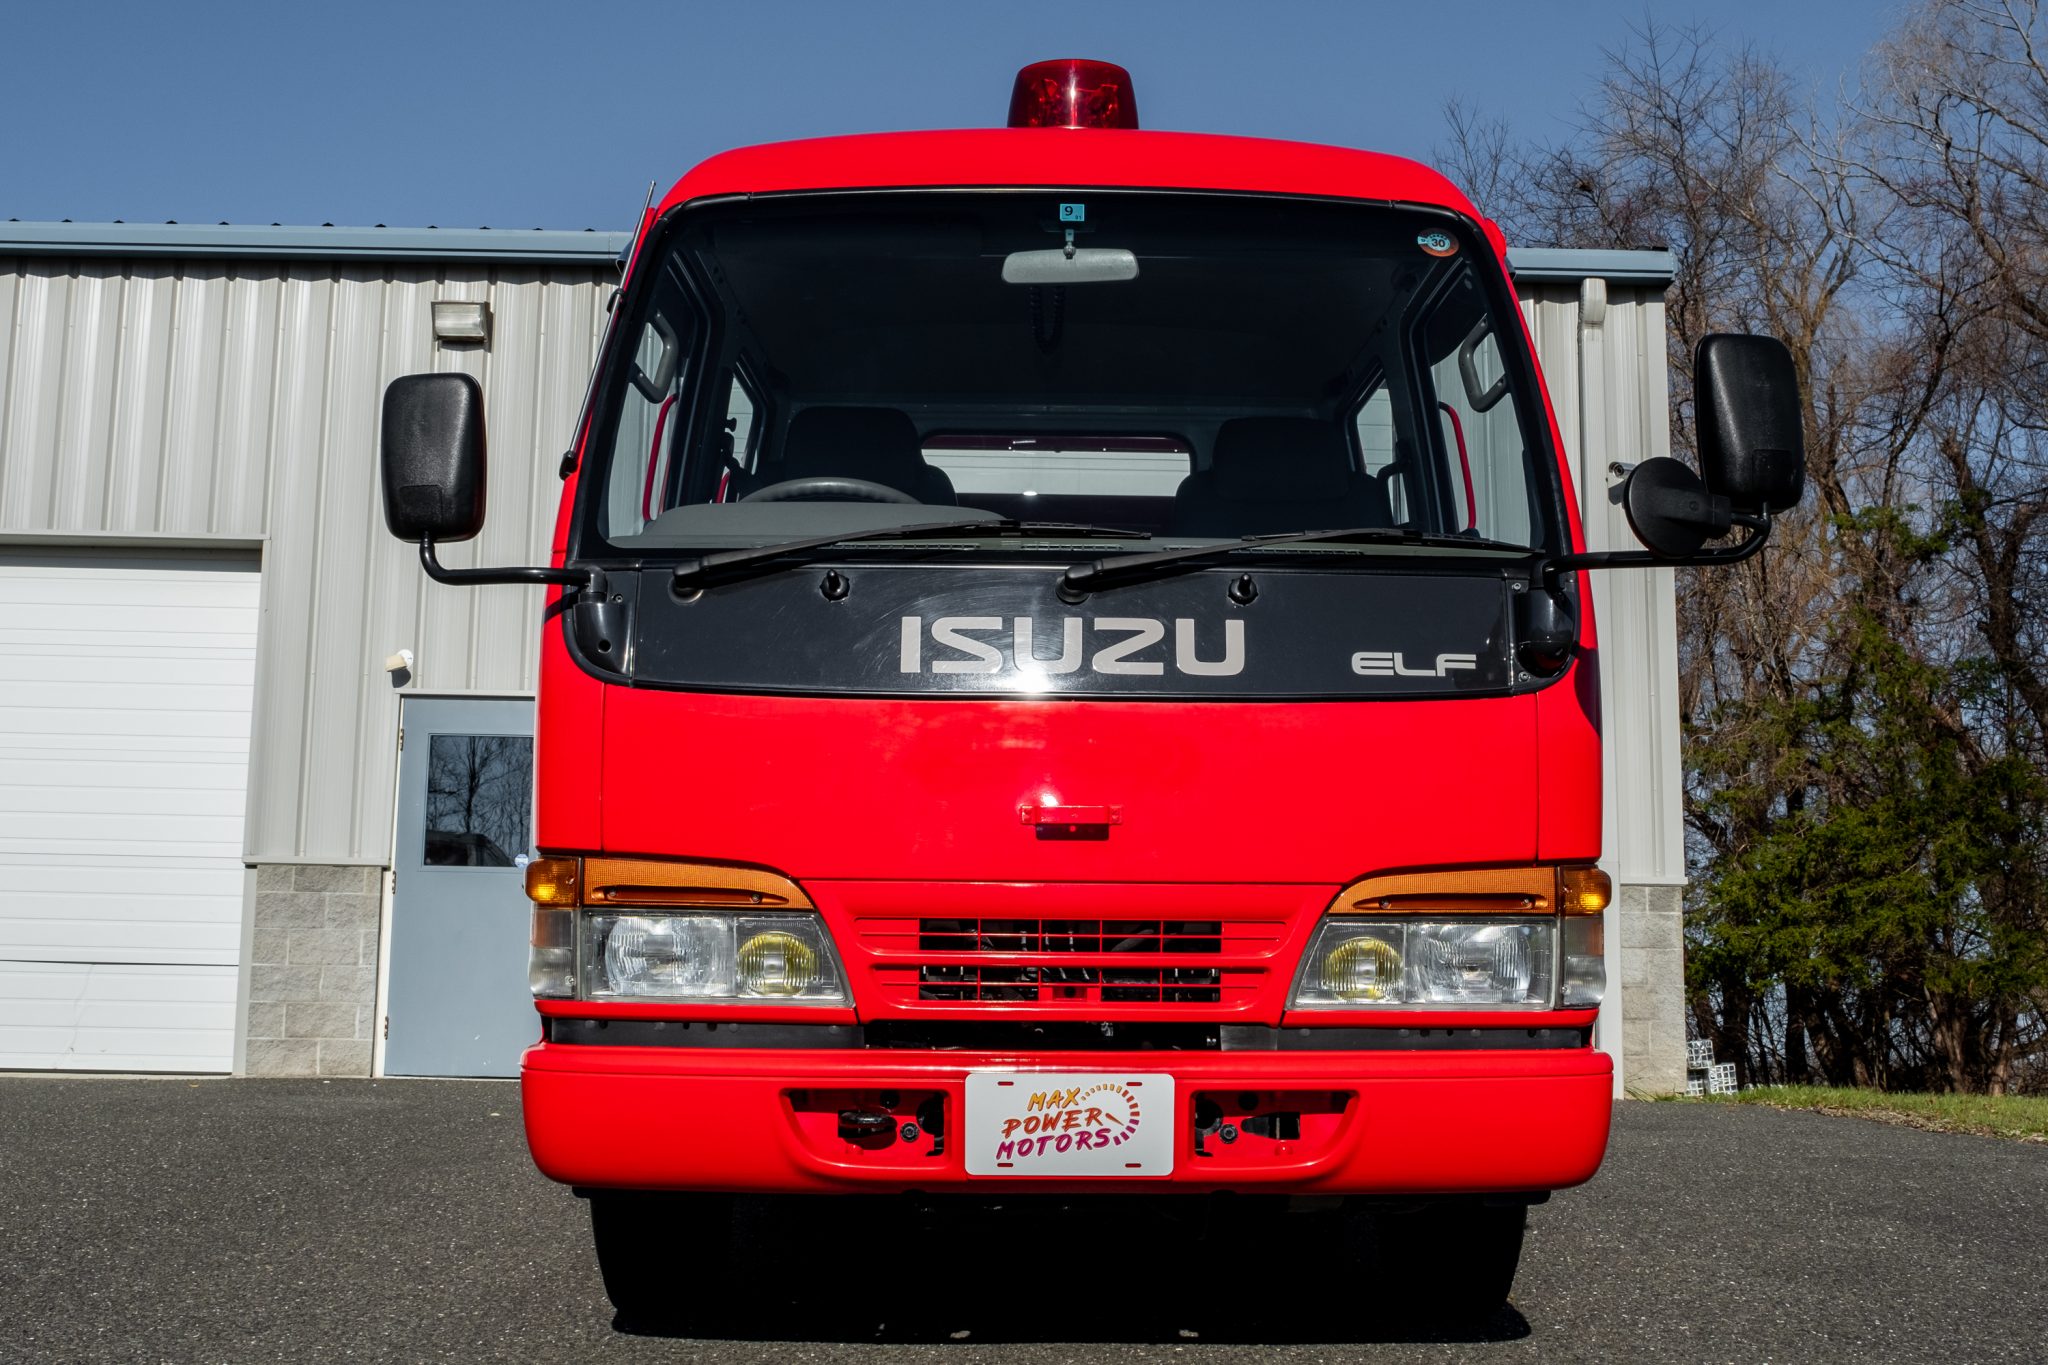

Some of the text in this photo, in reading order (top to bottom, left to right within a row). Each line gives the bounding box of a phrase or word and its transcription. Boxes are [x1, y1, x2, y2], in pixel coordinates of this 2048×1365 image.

[1064, 205, 1073, 216] 9
[1431, 238, 1446, 248] 30
[900, 616, 1245, 676] ISUZU
[1351, 651, 1477, 677] ELF
[1027, 1087, 1080, 1112] MAX
[1001, 1107, 1103, 1139] POWER
[996, 1128, 1111, 1160] MOTORS
